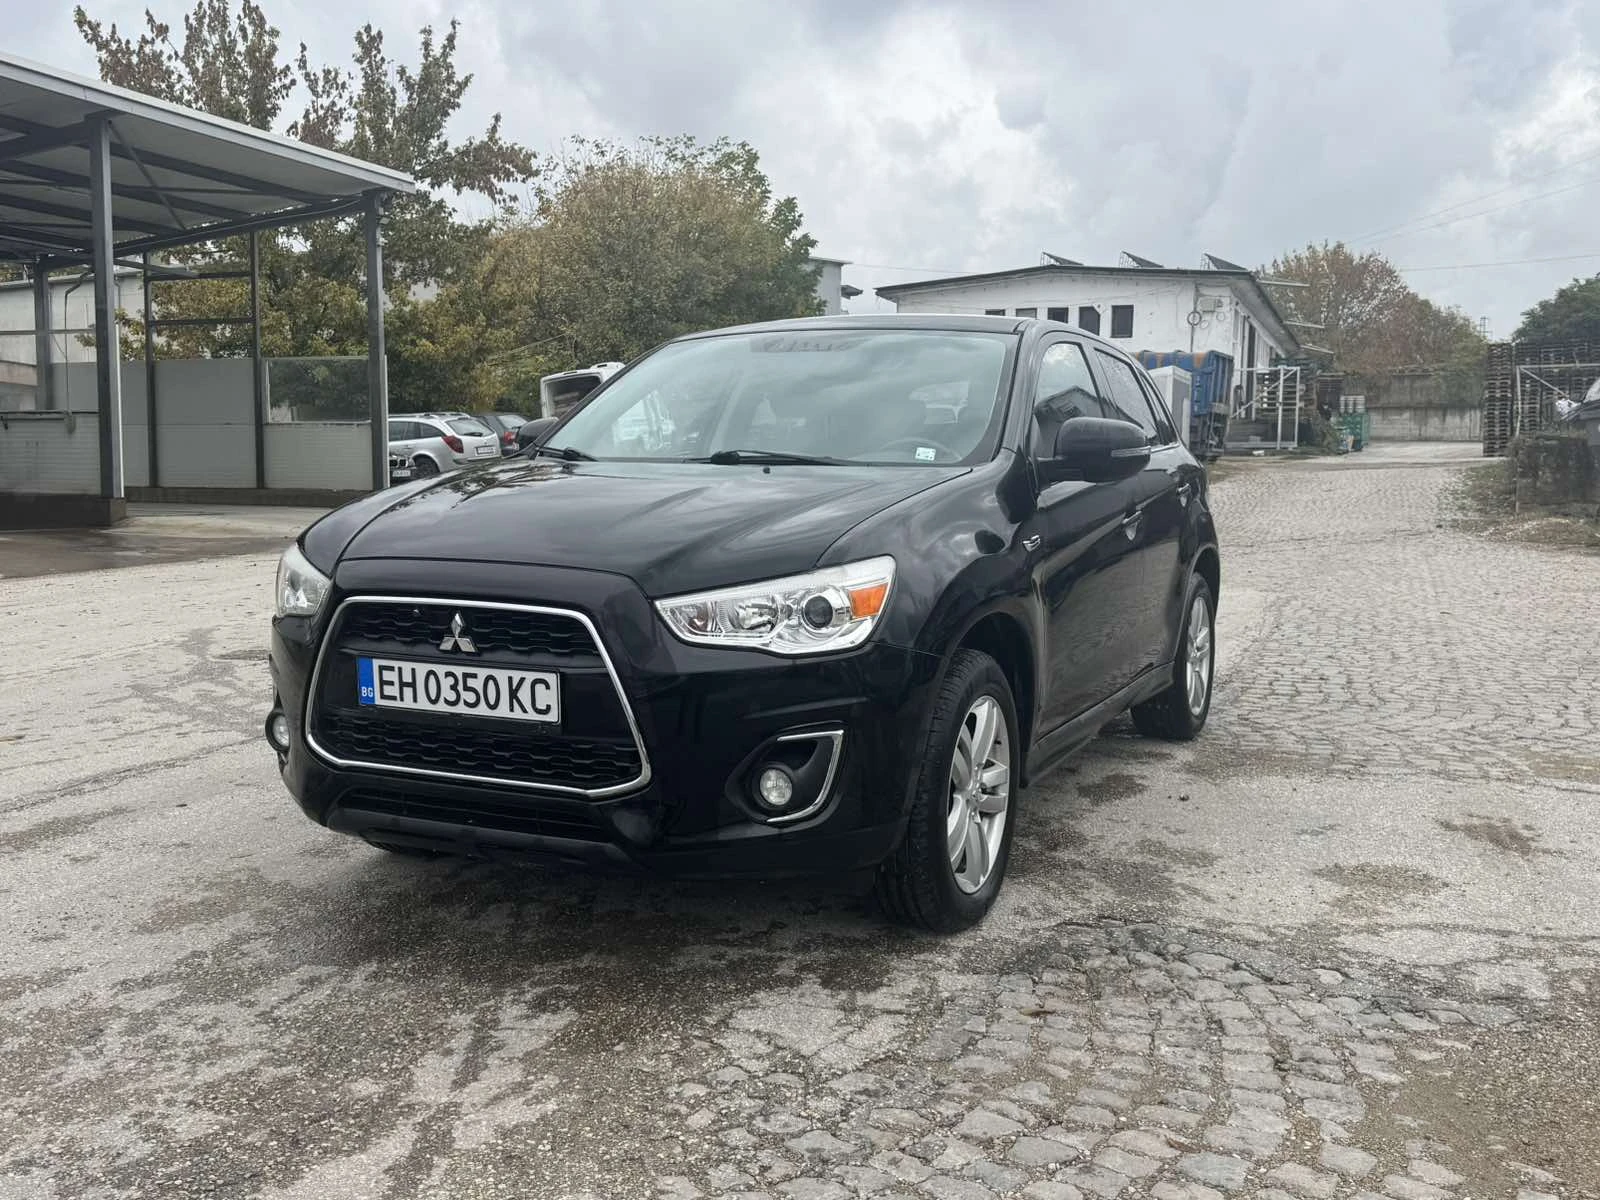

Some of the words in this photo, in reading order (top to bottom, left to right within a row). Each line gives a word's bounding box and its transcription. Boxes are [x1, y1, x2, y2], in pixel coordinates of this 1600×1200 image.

[361, 686, 374, 698] BG
[378, 665, 418, 703] EH
[424, 669, 500, 711] 0350
[508, 676, 552, 715] KC
